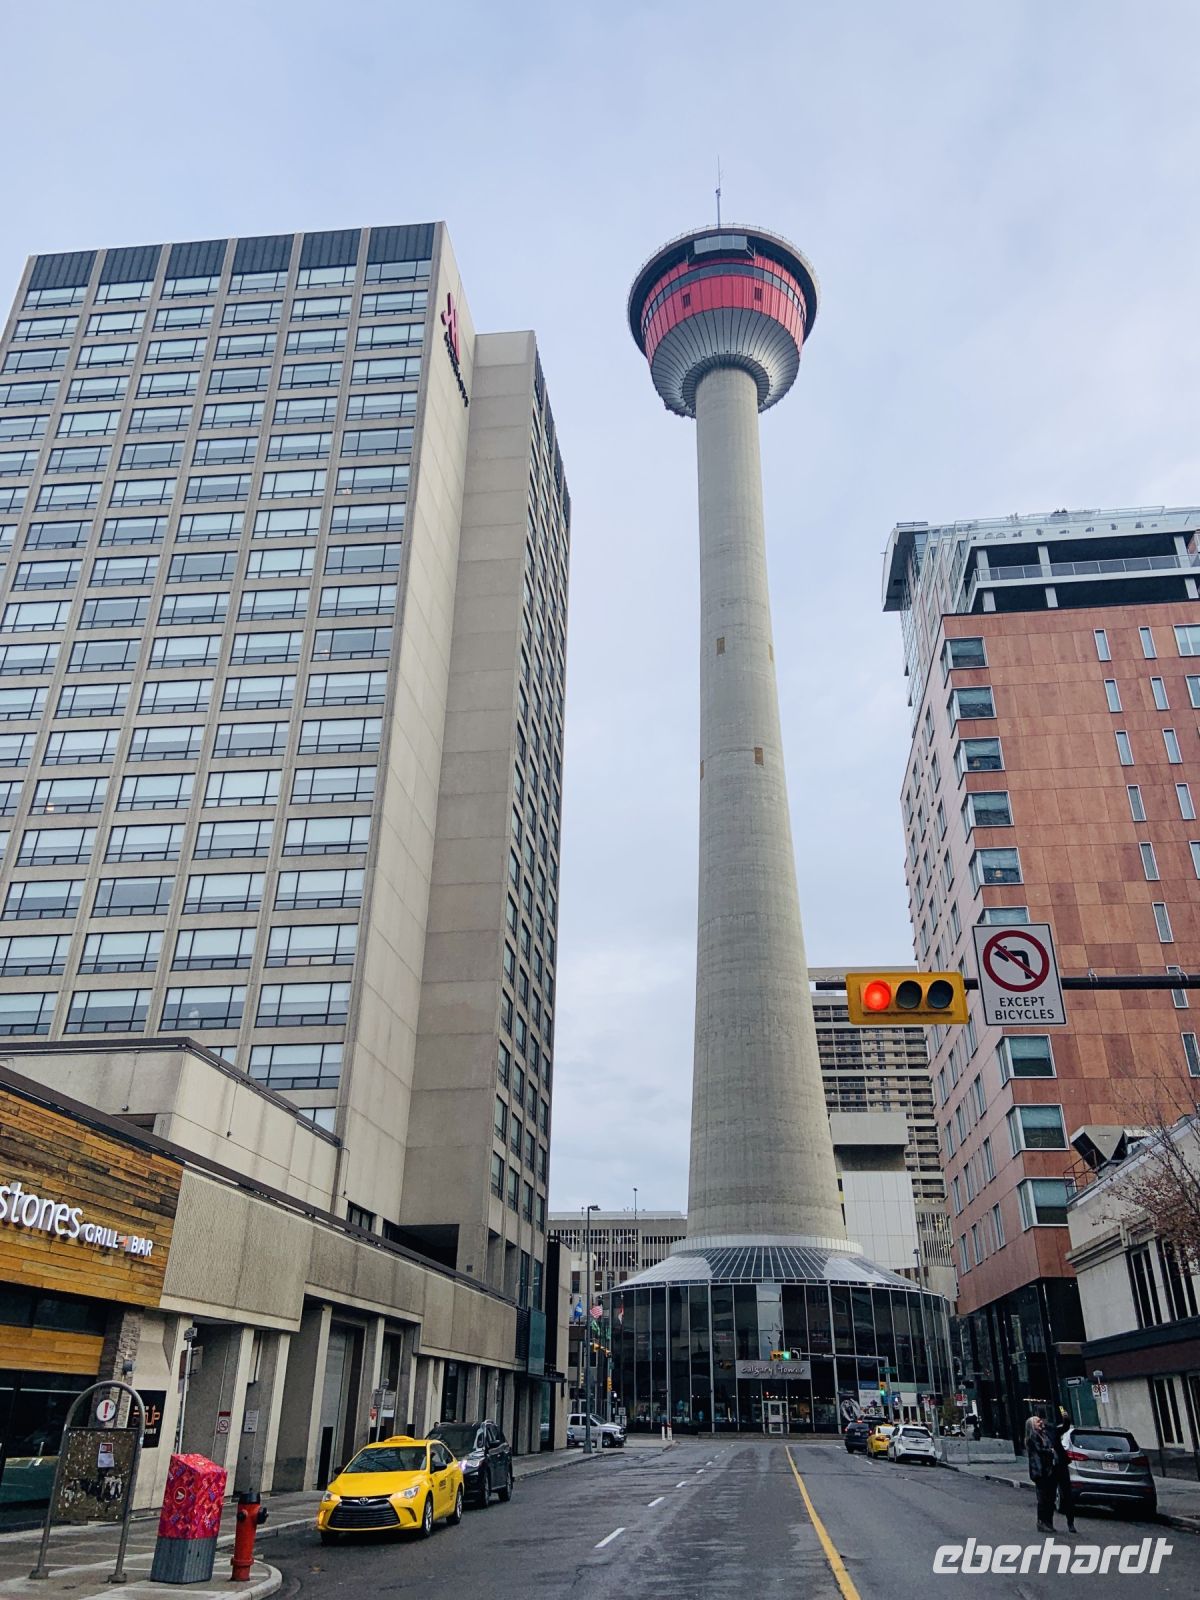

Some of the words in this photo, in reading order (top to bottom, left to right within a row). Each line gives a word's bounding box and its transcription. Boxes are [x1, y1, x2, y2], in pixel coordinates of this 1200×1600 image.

[999, 996, 1045, 1007] EXCEPT
[994, 1009, 1055, 1020] BICYCLES
[85, 1223, 119, 1248] GRILL
[130, 1235, 153, 1257] BAR
